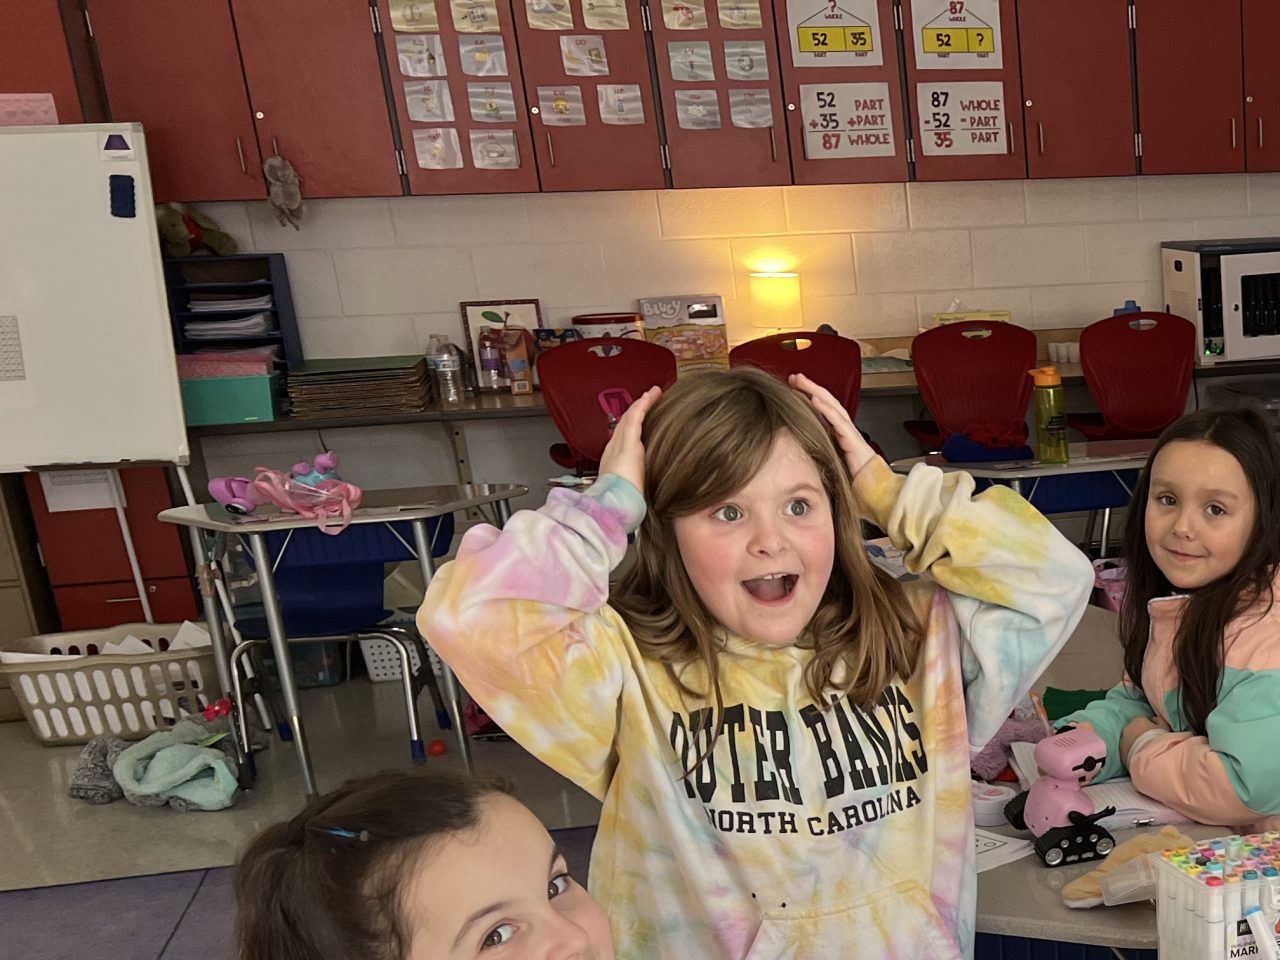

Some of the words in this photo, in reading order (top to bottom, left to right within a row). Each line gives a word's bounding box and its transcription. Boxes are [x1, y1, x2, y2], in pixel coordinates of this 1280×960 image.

[949, 1, 964, 14] 87
[812, 32, 828, 46] 52
[850, 32, 867, 46] 35
[936, 33, 951, 47] 52
[816, 92, 836, 108] 52
[855, 99, 884, 111] PART
[931, 91, 949, 107] 87
[960, 99, 1000, 111] WHOLE
[822, 133, 841, 150] 87
[848, 133, 890, 146] WHOLE
[934, 132, 953, 148] 35
[971, 132, 999, 143] PART
[670, 703, 803, 805] OUTER
[799, 686, 928, 799] BANKS
[704, 806, 798, 834] NORTH
[807, 786, 921, 836] CAROLINA
